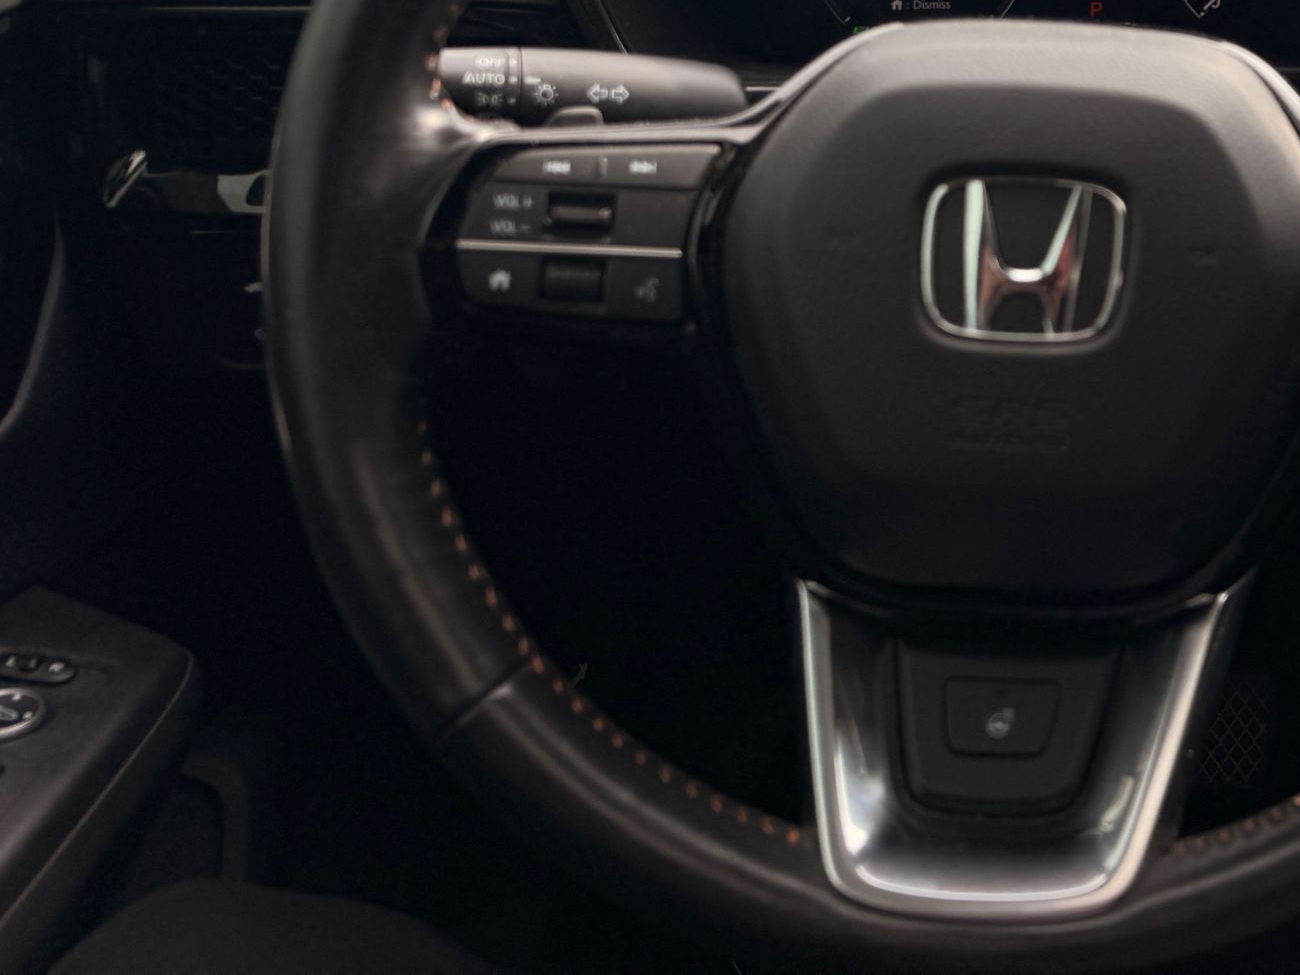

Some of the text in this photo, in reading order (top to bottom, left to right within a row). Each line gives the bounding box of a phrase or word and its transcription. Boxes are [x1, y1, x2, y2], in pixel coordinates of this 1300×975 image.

[912, 0, 952, 10] Dismiss
[1089, 1, 1103, 18] P
[463, 72, 506, 86] AUTO
